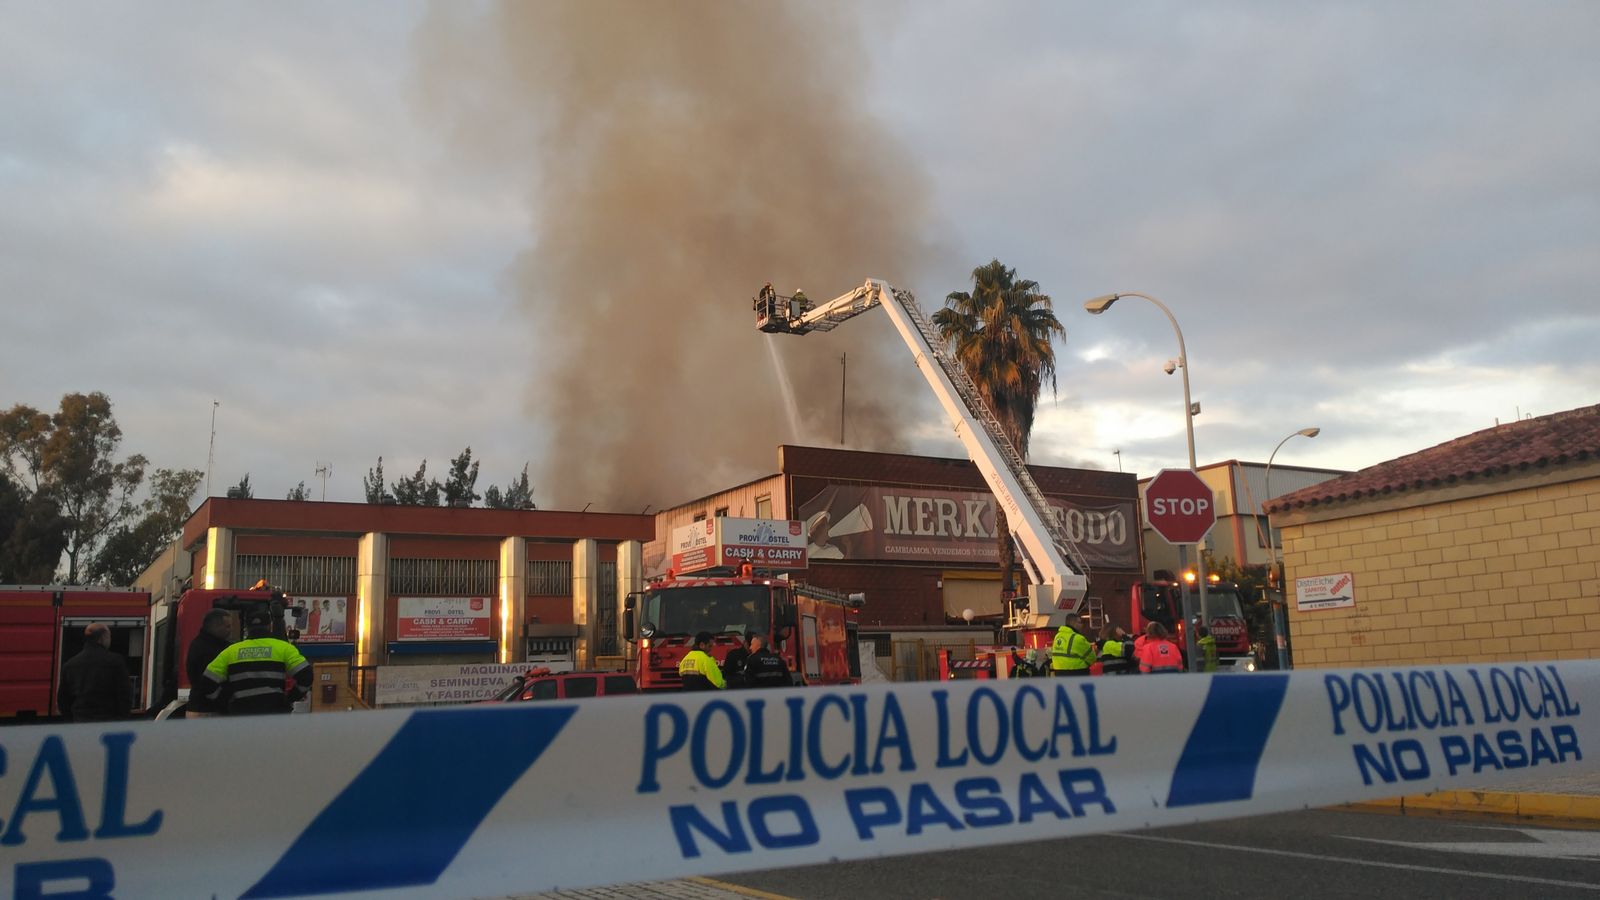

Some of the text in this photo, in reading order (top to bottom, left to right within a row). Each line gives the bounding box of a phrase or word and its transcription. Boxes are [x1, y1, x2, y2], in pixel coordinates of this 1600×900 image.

[1153, 497, 1208, 516] STOP
[725, 547, 803, 559] CASH & CARRY
[932, 548, 971, 556] VENDEMOS
[1330, 575, 1351, 595] outlet
[430, 677, 508, 688] SEMINUEVA,
[425, 691, 432, 699] Y
[1324, 665, 1580, 735] POLICIA LOCAL
[636, 683, 1117, 793] POLICIA LOCAL
[1352, 724, 1582, 786] NO PASAR
[0, 731, 164, 846] AL
[669, 767, 1117, 859] NO PASAR
